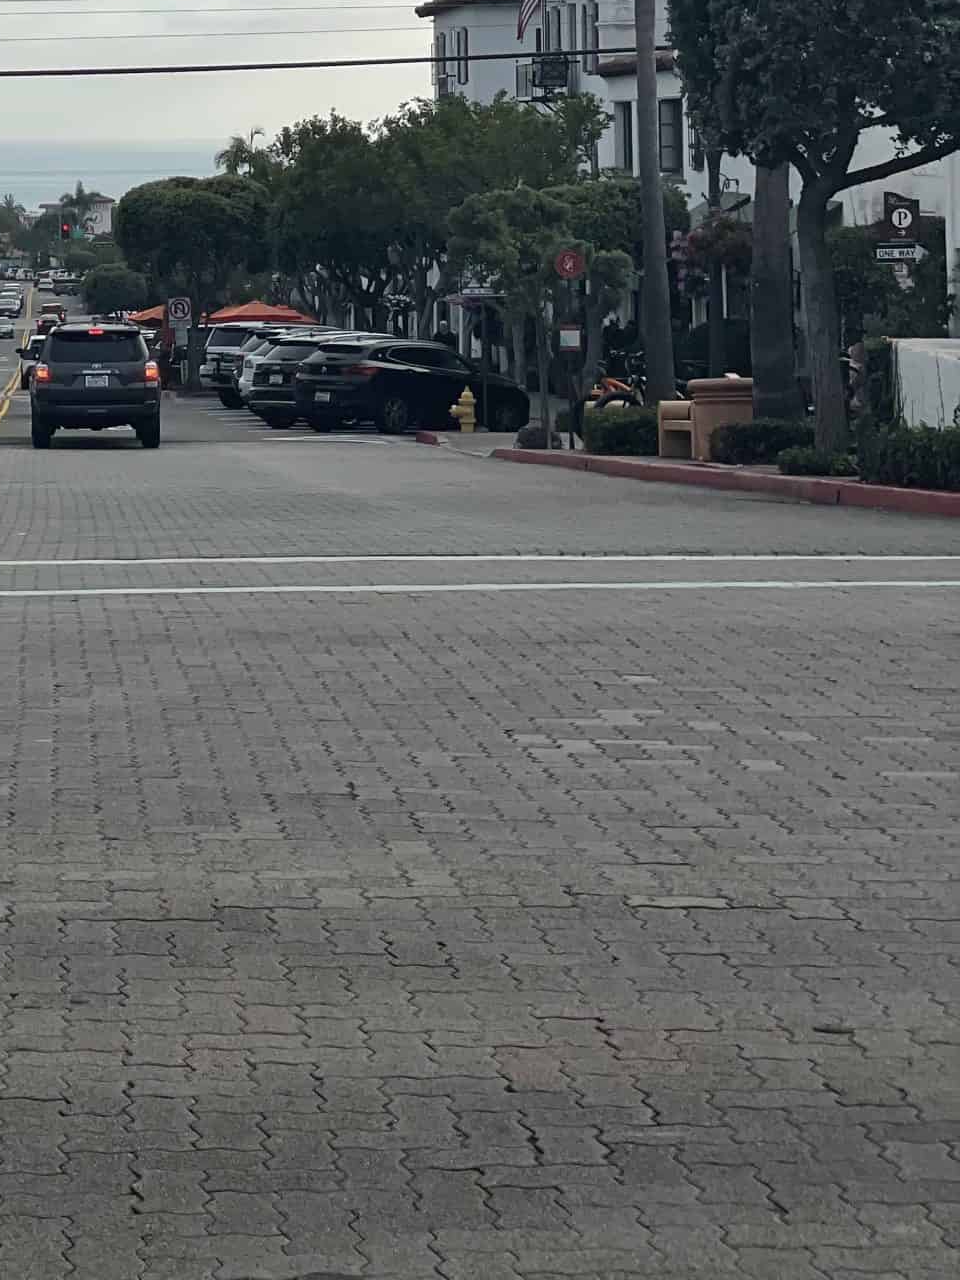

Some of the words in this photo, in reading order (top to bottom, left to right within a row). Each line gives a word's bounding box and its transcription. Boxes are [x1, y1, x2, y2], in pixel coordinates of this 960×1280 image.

[898, 211, 908, 226] P
[878, 249, 896, 258] ONE
[898, 249, 915, 258] WAY
